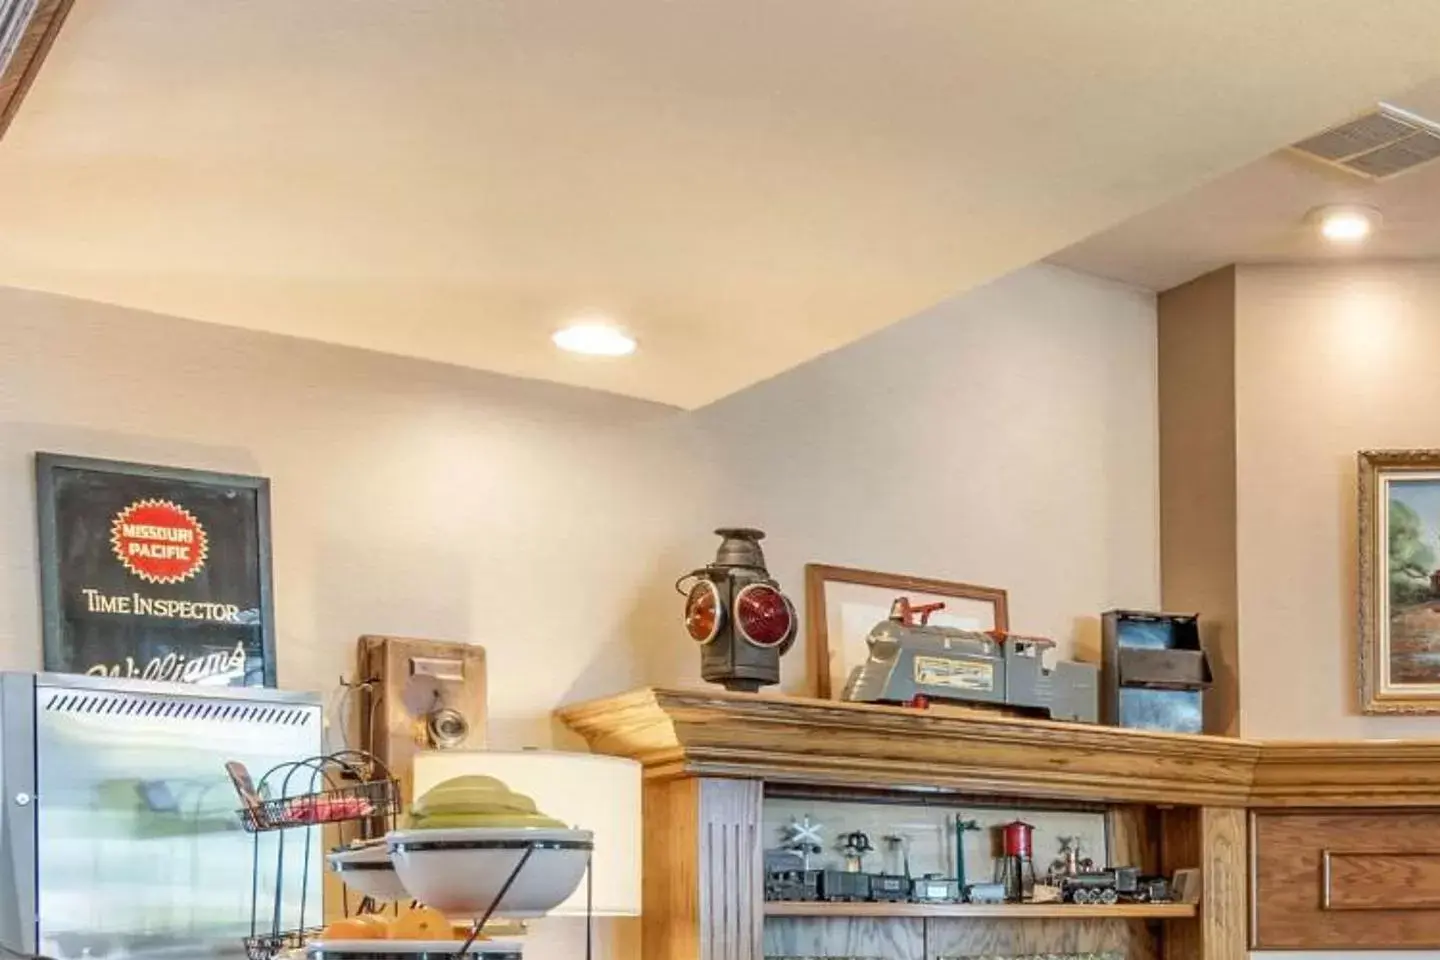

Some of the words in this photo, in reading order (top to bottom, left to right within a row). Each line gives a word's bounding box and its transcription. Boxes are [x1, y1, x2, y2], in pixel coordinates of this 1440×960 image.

[123, 524, 193, 543] MISSOURI
[127, 543, 191, 560] PACIFIC
[82, 588, 131, 614] TIME
[133, 593, 240, 621] INSPECTOR
